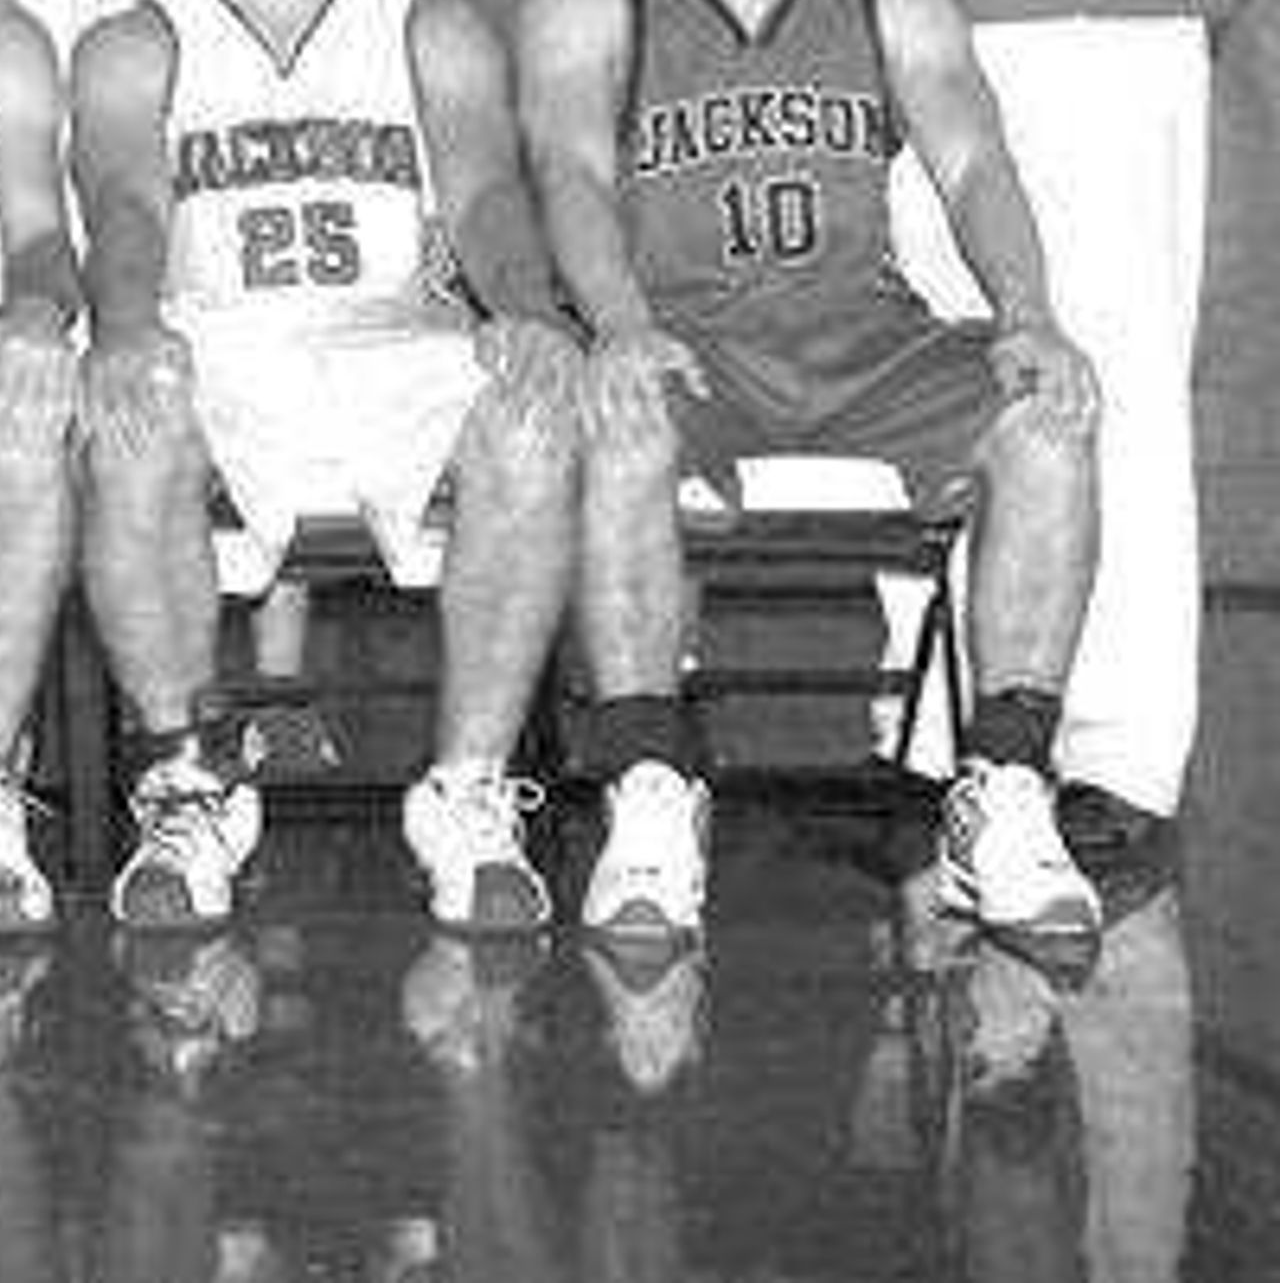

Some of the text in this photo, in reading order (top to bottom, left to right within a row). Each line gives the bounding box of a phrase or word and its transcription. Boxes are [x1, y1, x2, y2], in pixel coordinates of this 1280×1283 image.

[635, 85, 902, 177] JACKSON
[237, 202, 358, 292] 25
[717, 177, 820, 264] 10
